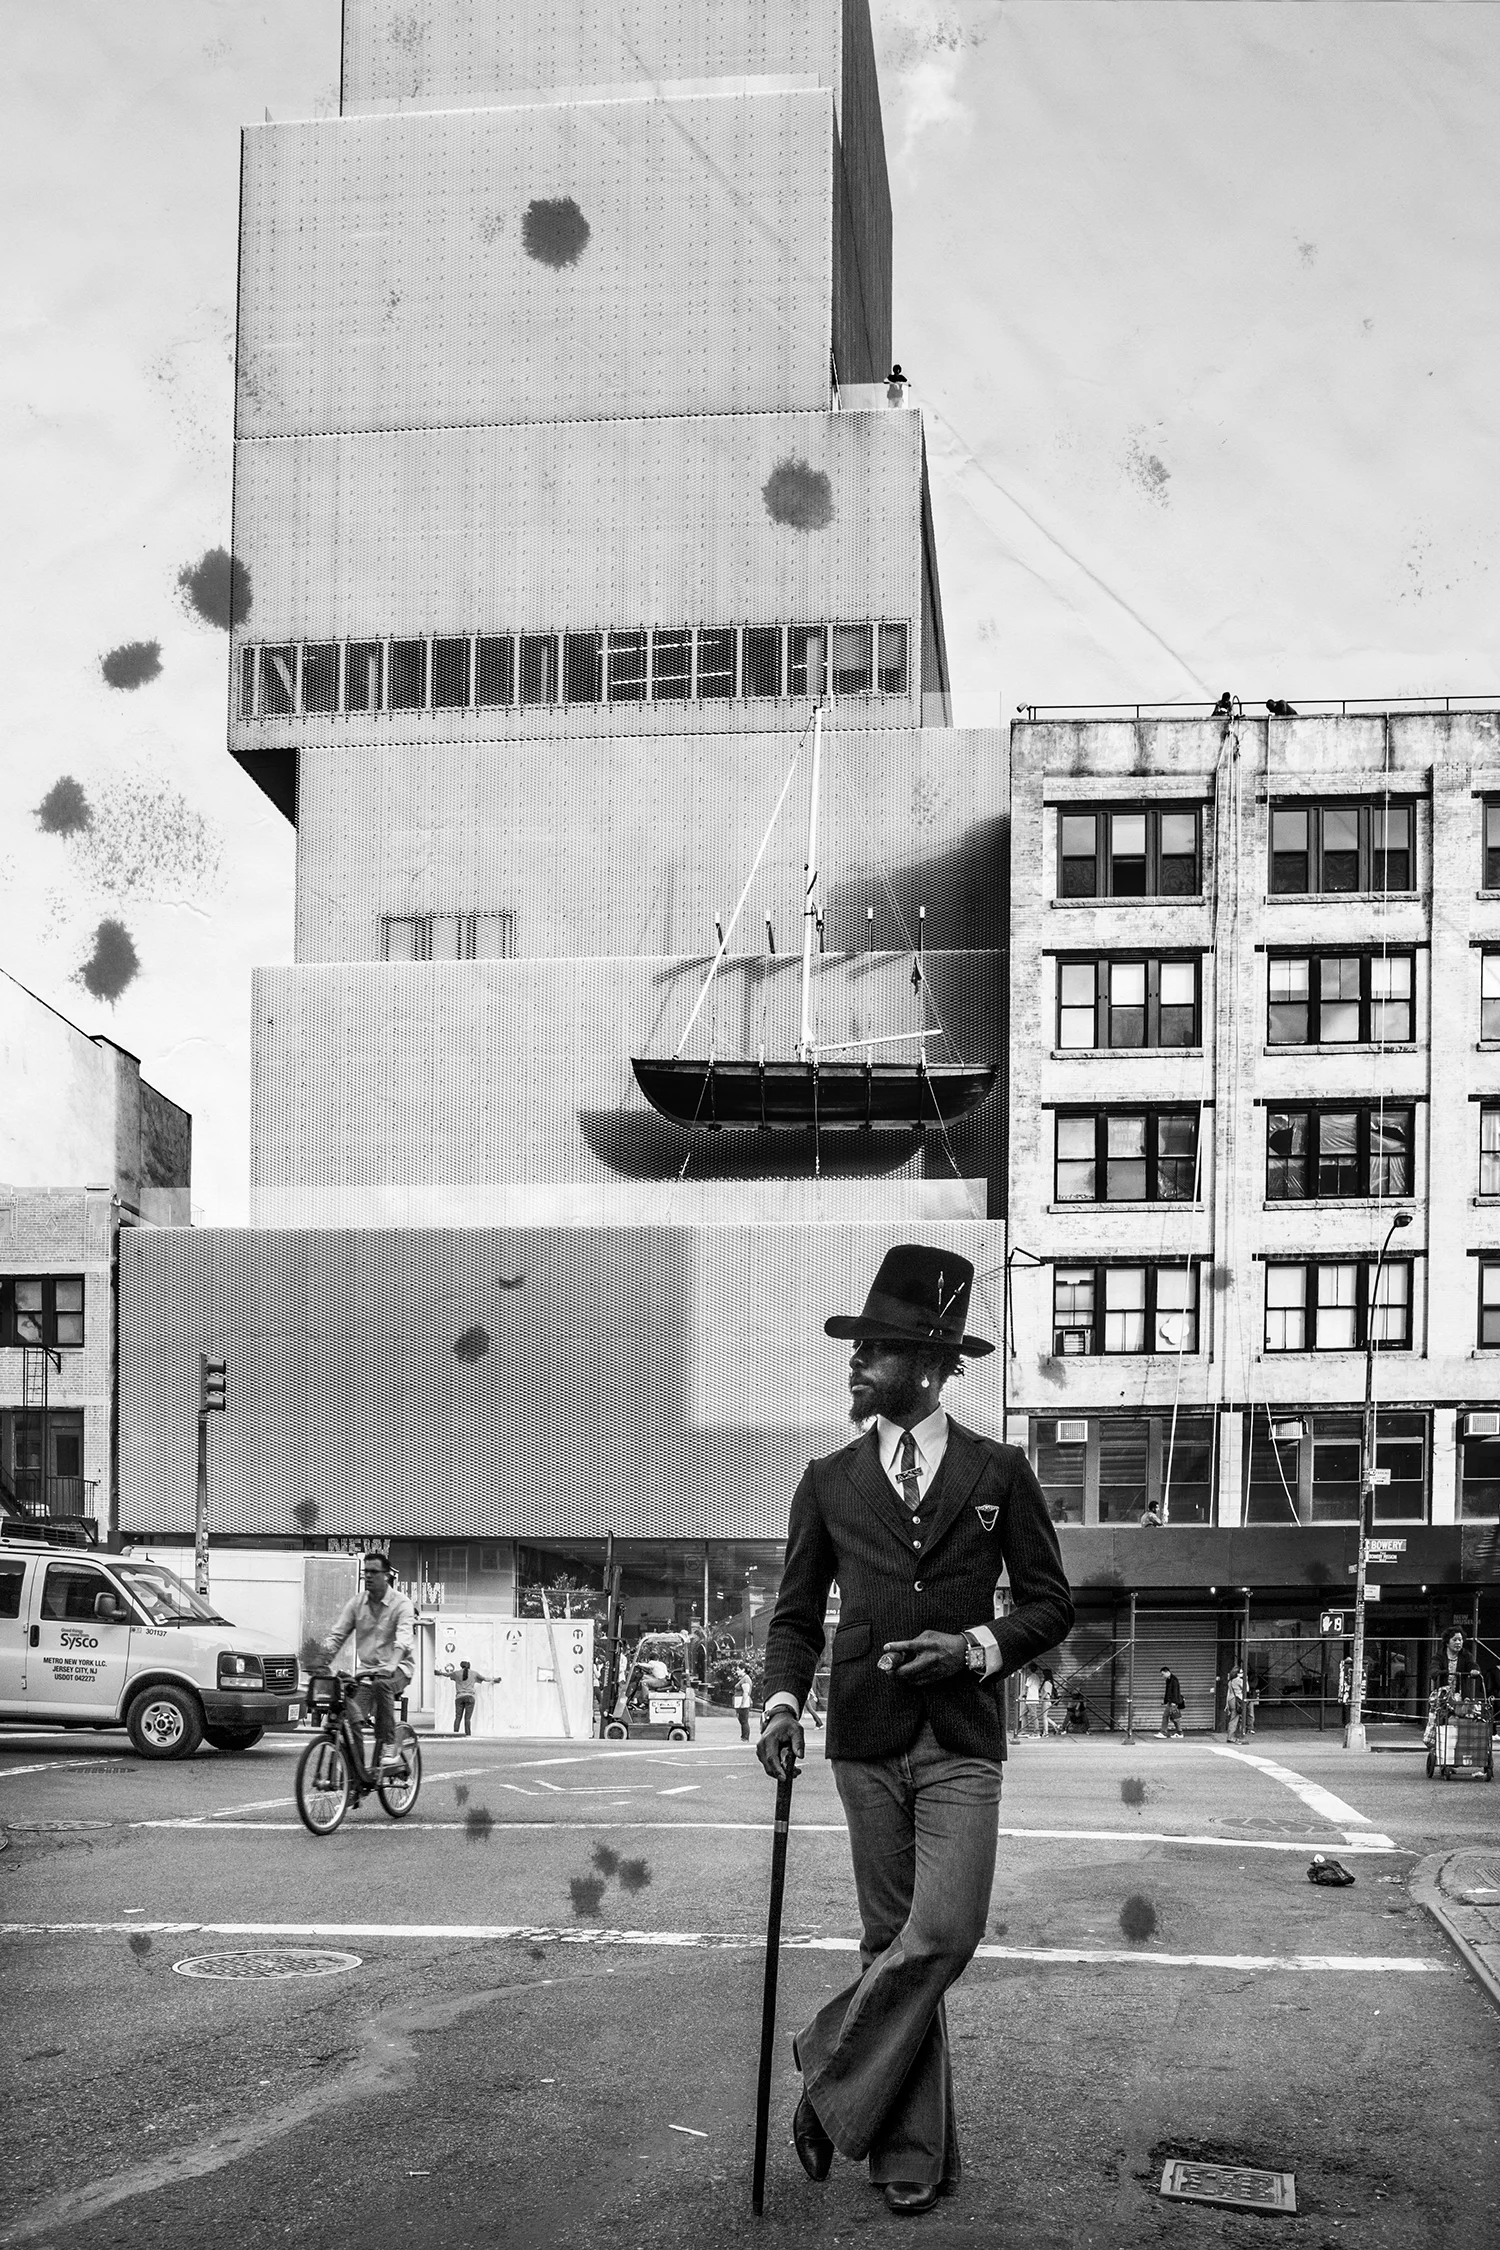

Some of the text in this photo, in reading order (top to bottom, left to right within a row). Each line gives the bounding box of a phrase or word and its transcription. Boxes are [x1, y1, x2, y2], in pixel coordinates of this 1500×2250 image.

[1371, 1540, 1403, 1550] BOWERY
[1334, 1617, 1342, 1631] 19
[145, 1628, 167, 1637] 301137
[60, 1633, 98, 1650] Sysco
[52, 1665, 74, 1673] JERSEY
[75, 1666, 89, 1674] CITY,
[74, 1674, 96, 1682] 042273
